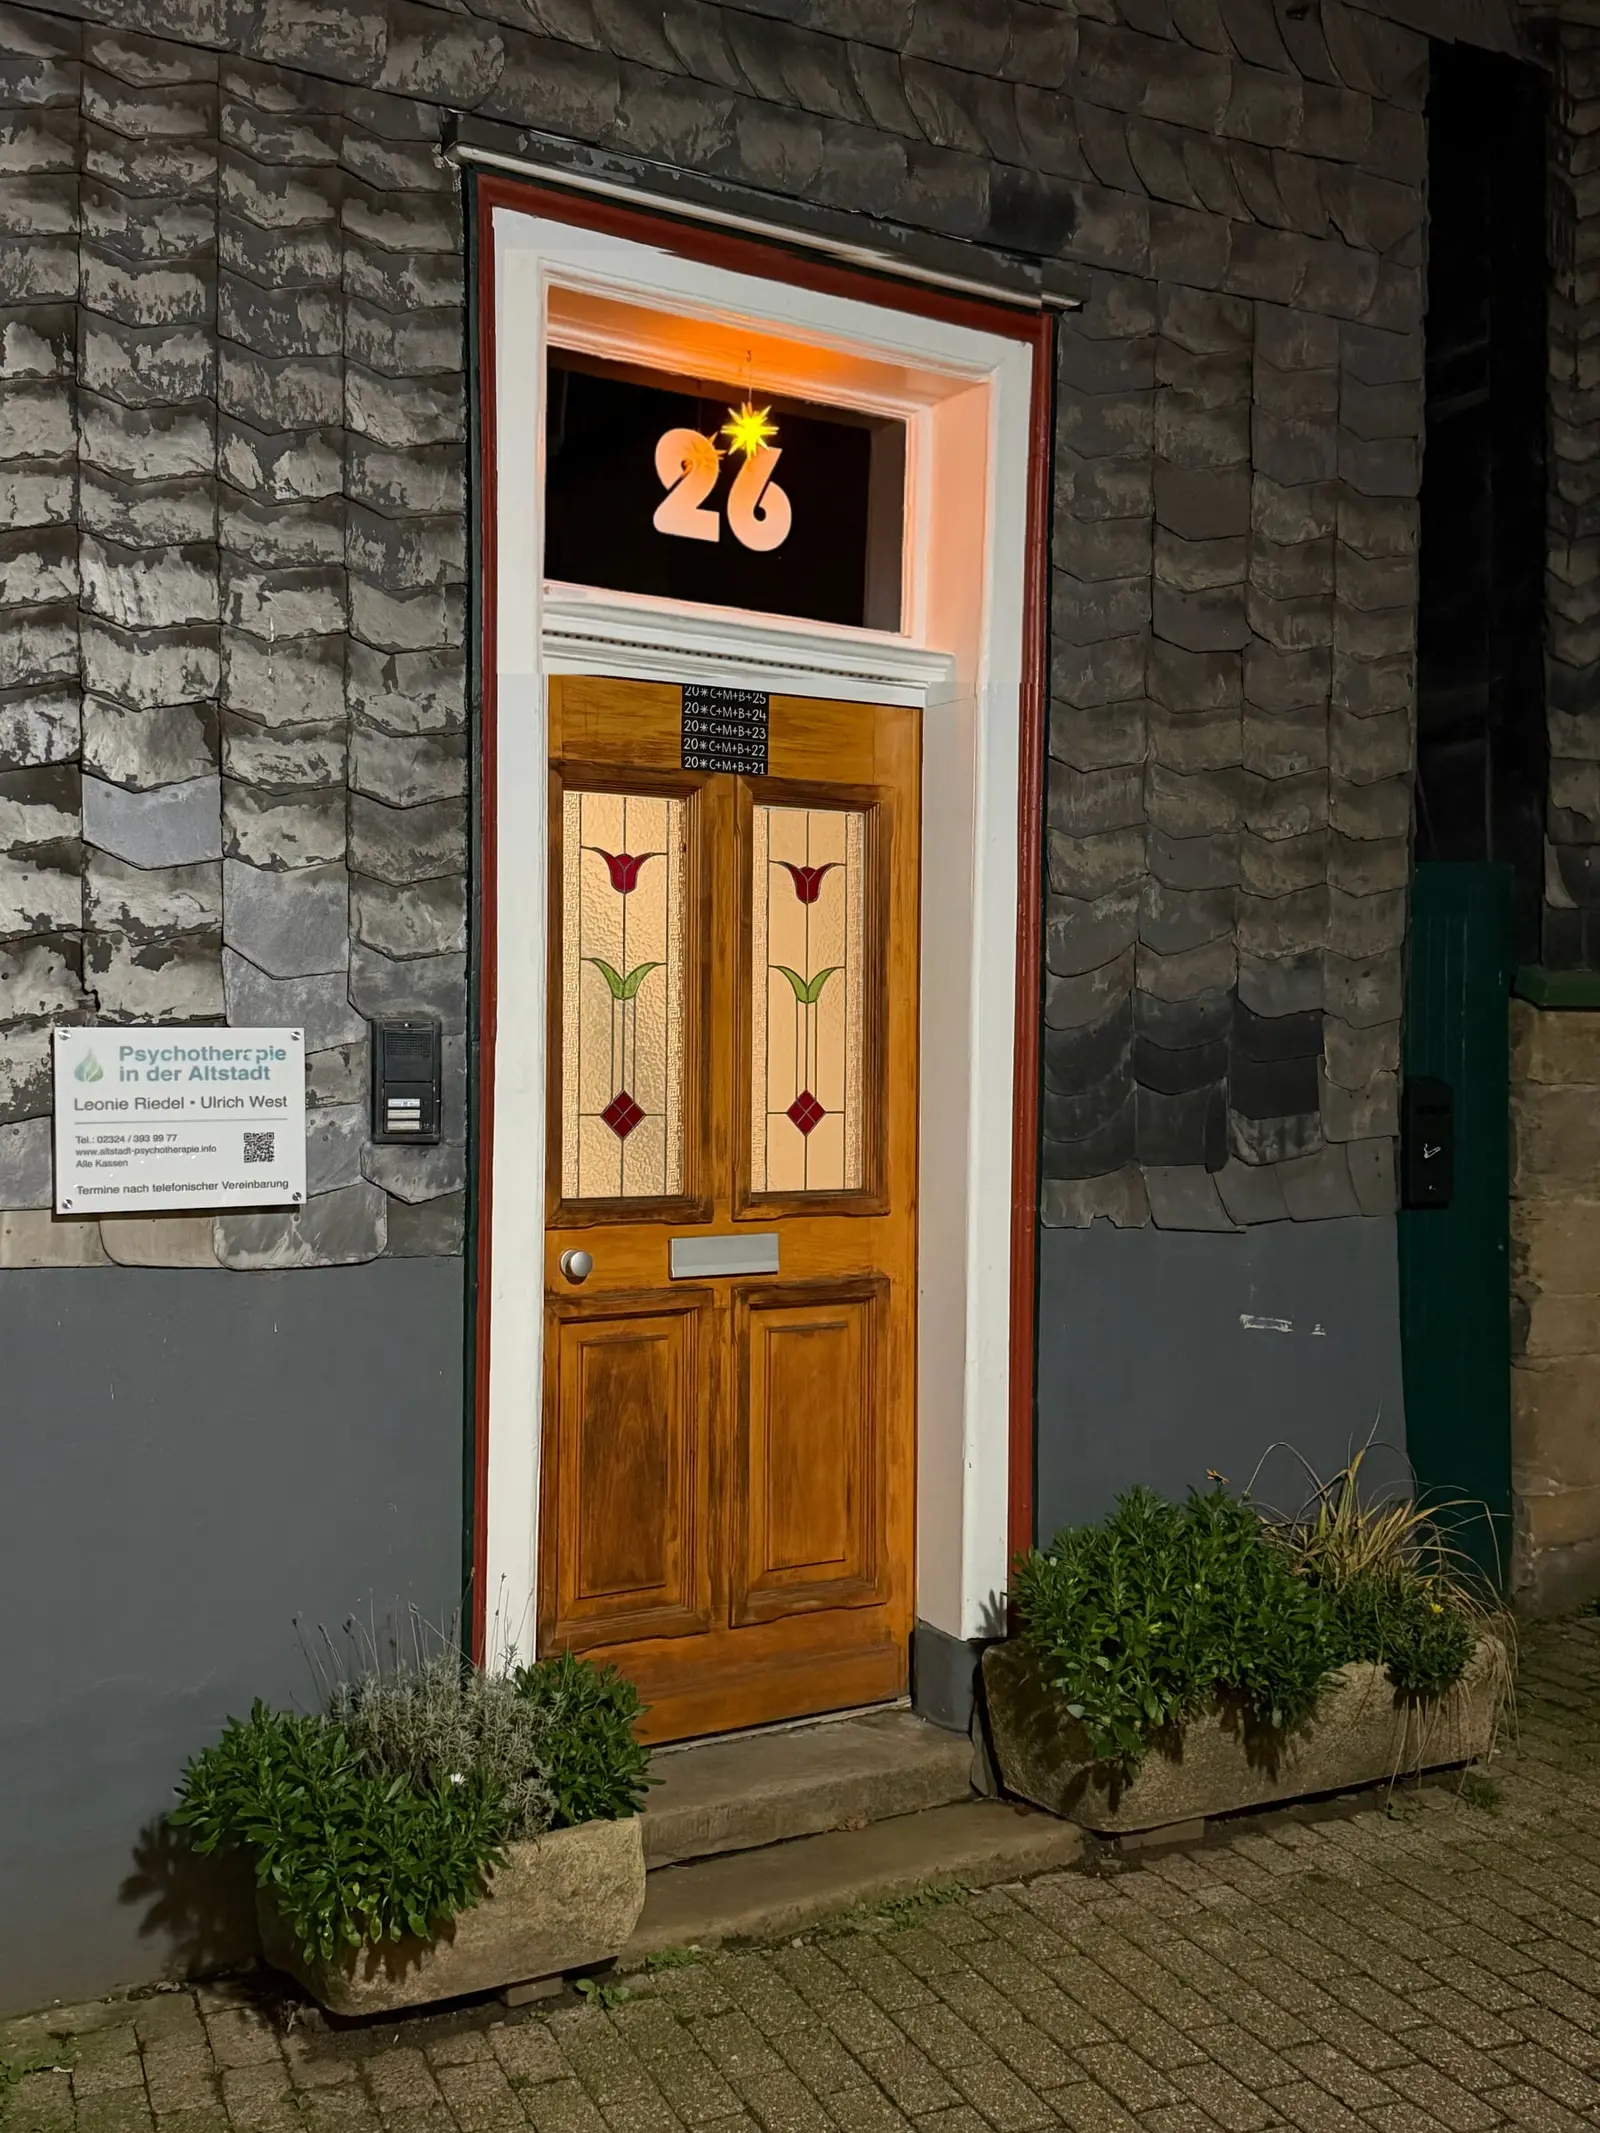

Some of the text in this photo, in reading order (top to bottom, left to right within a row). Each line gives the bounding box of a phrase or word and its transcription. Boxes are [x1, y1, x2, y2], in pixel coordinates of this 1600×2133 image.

[653, 428, 792, 551] 26
[120, 1066, 270, 1082] in der Altstadt
[74, 1096, 287, 1111] Leonie Riedel Ulrich West
[76, 1135, 95, 1144] Tel.:
[97, 1135, 125, 1143] 02324
[133, 1134, 149, 1143] 393
[153, 1134, 164, 1142] 99
[166, 1134, 177, 1142] 77
[76, 1145, 216, 1156] www.altstadt-psychotherapie.info
[76, 1159, 128, 1168] Alle Kassen
[77, 1180, 288, 1195] Termine nach telefonischer Vereinbarung
